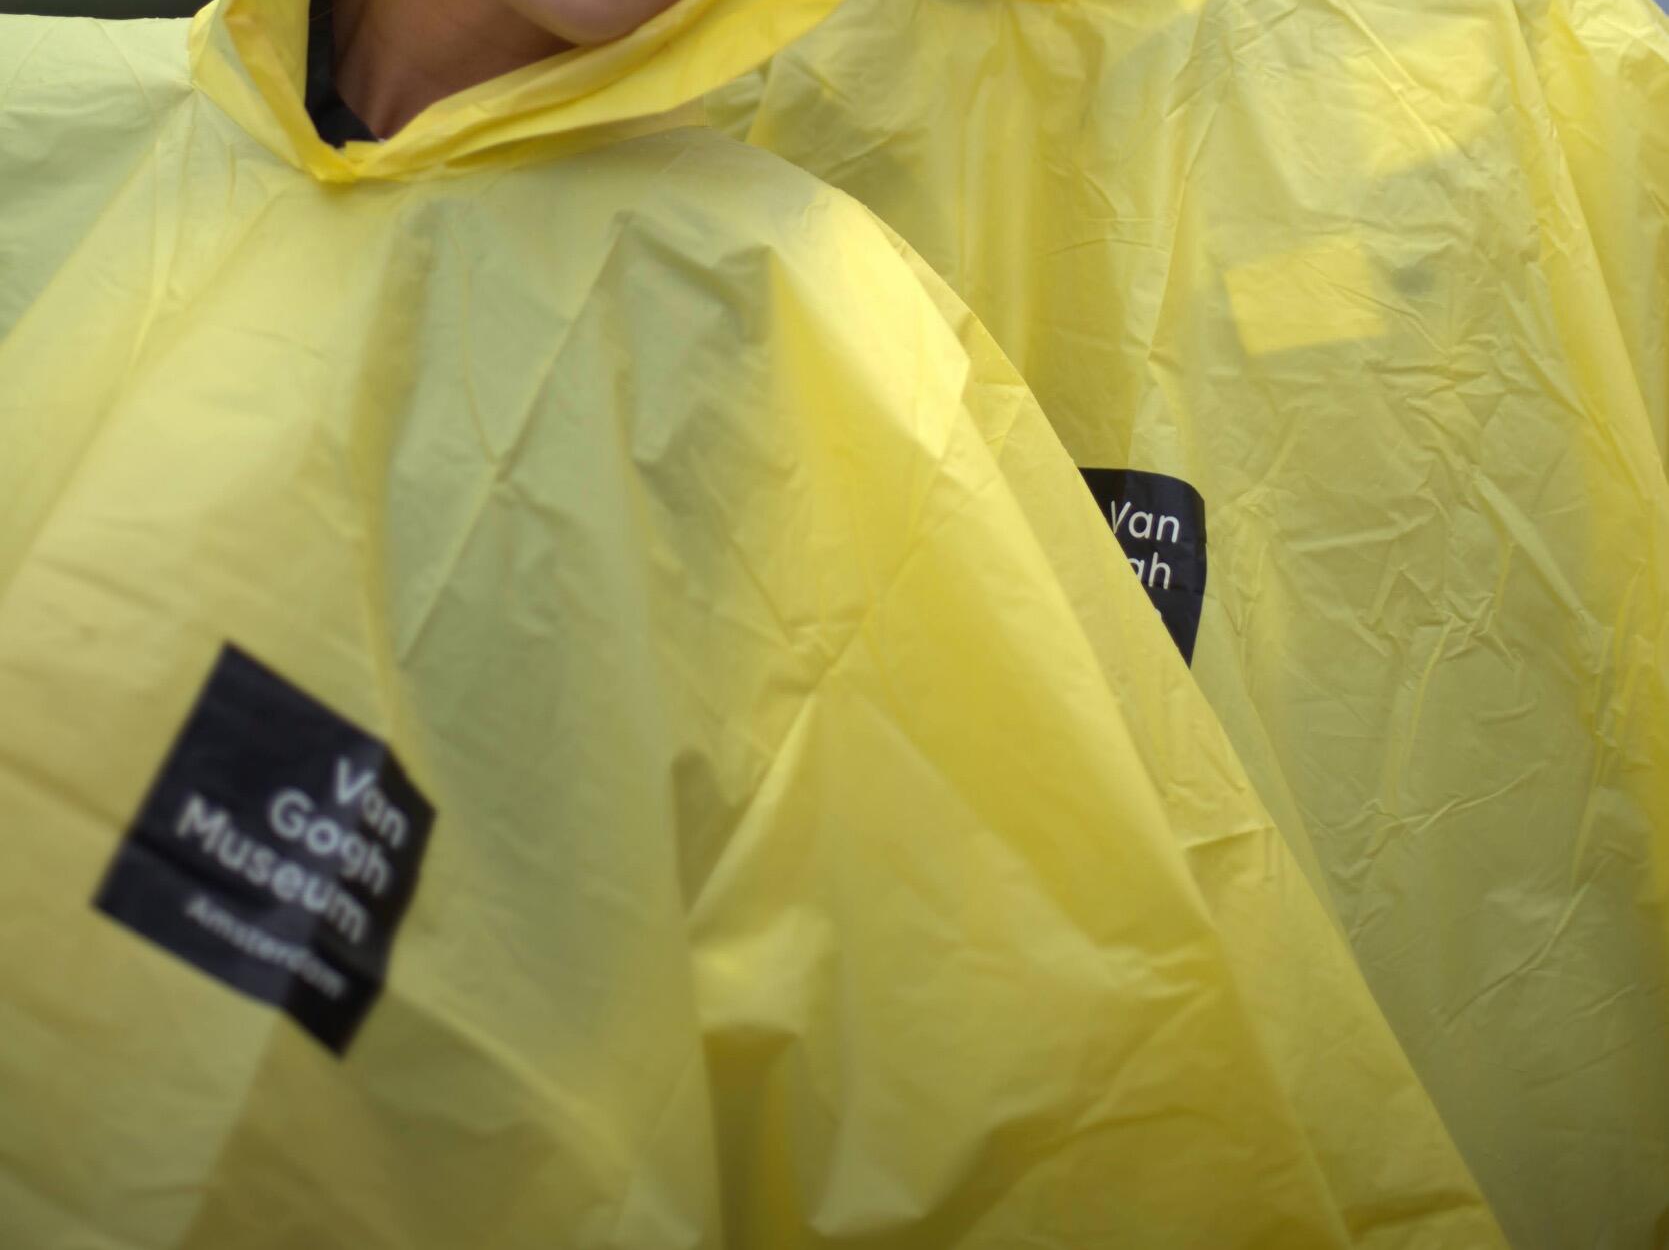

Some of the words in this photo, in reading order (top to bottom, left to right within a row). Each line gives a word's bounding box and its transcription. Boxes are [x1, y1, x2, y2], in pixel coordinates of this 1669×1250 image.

[1111, 500, 1180, 544] Van
[268, 788, 391, 895] Gogh
[335, 757, 409, 848] Van
[176, 794, 367, 944] Museum
